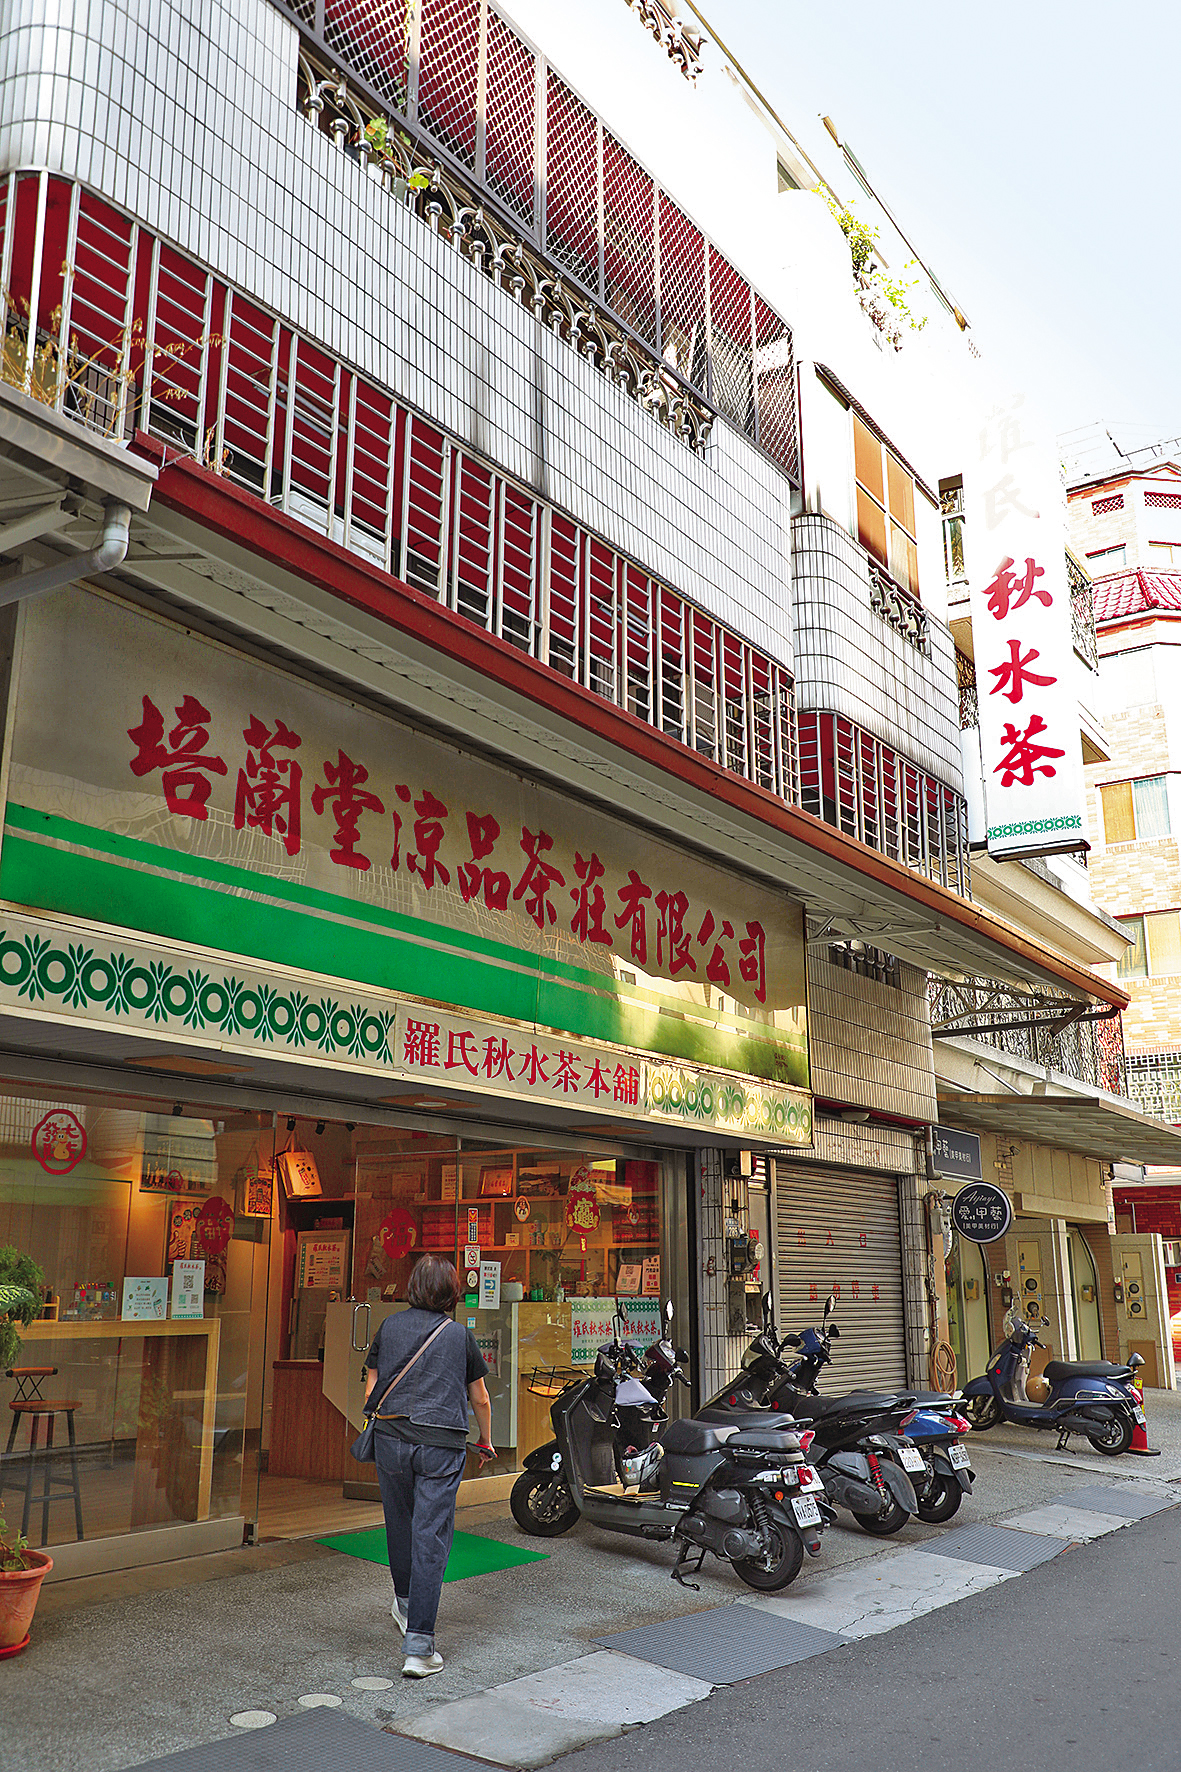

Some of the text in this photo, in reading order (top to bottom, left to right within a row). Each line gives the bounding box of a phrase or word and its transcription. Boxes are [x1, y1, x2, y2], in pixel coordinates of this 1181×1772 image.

[127, 694, 767, 1004] 培蘭堂涼品茶莊有限公司
[403, 1018, 640, 1106] 羅氏秋水茶本舖
